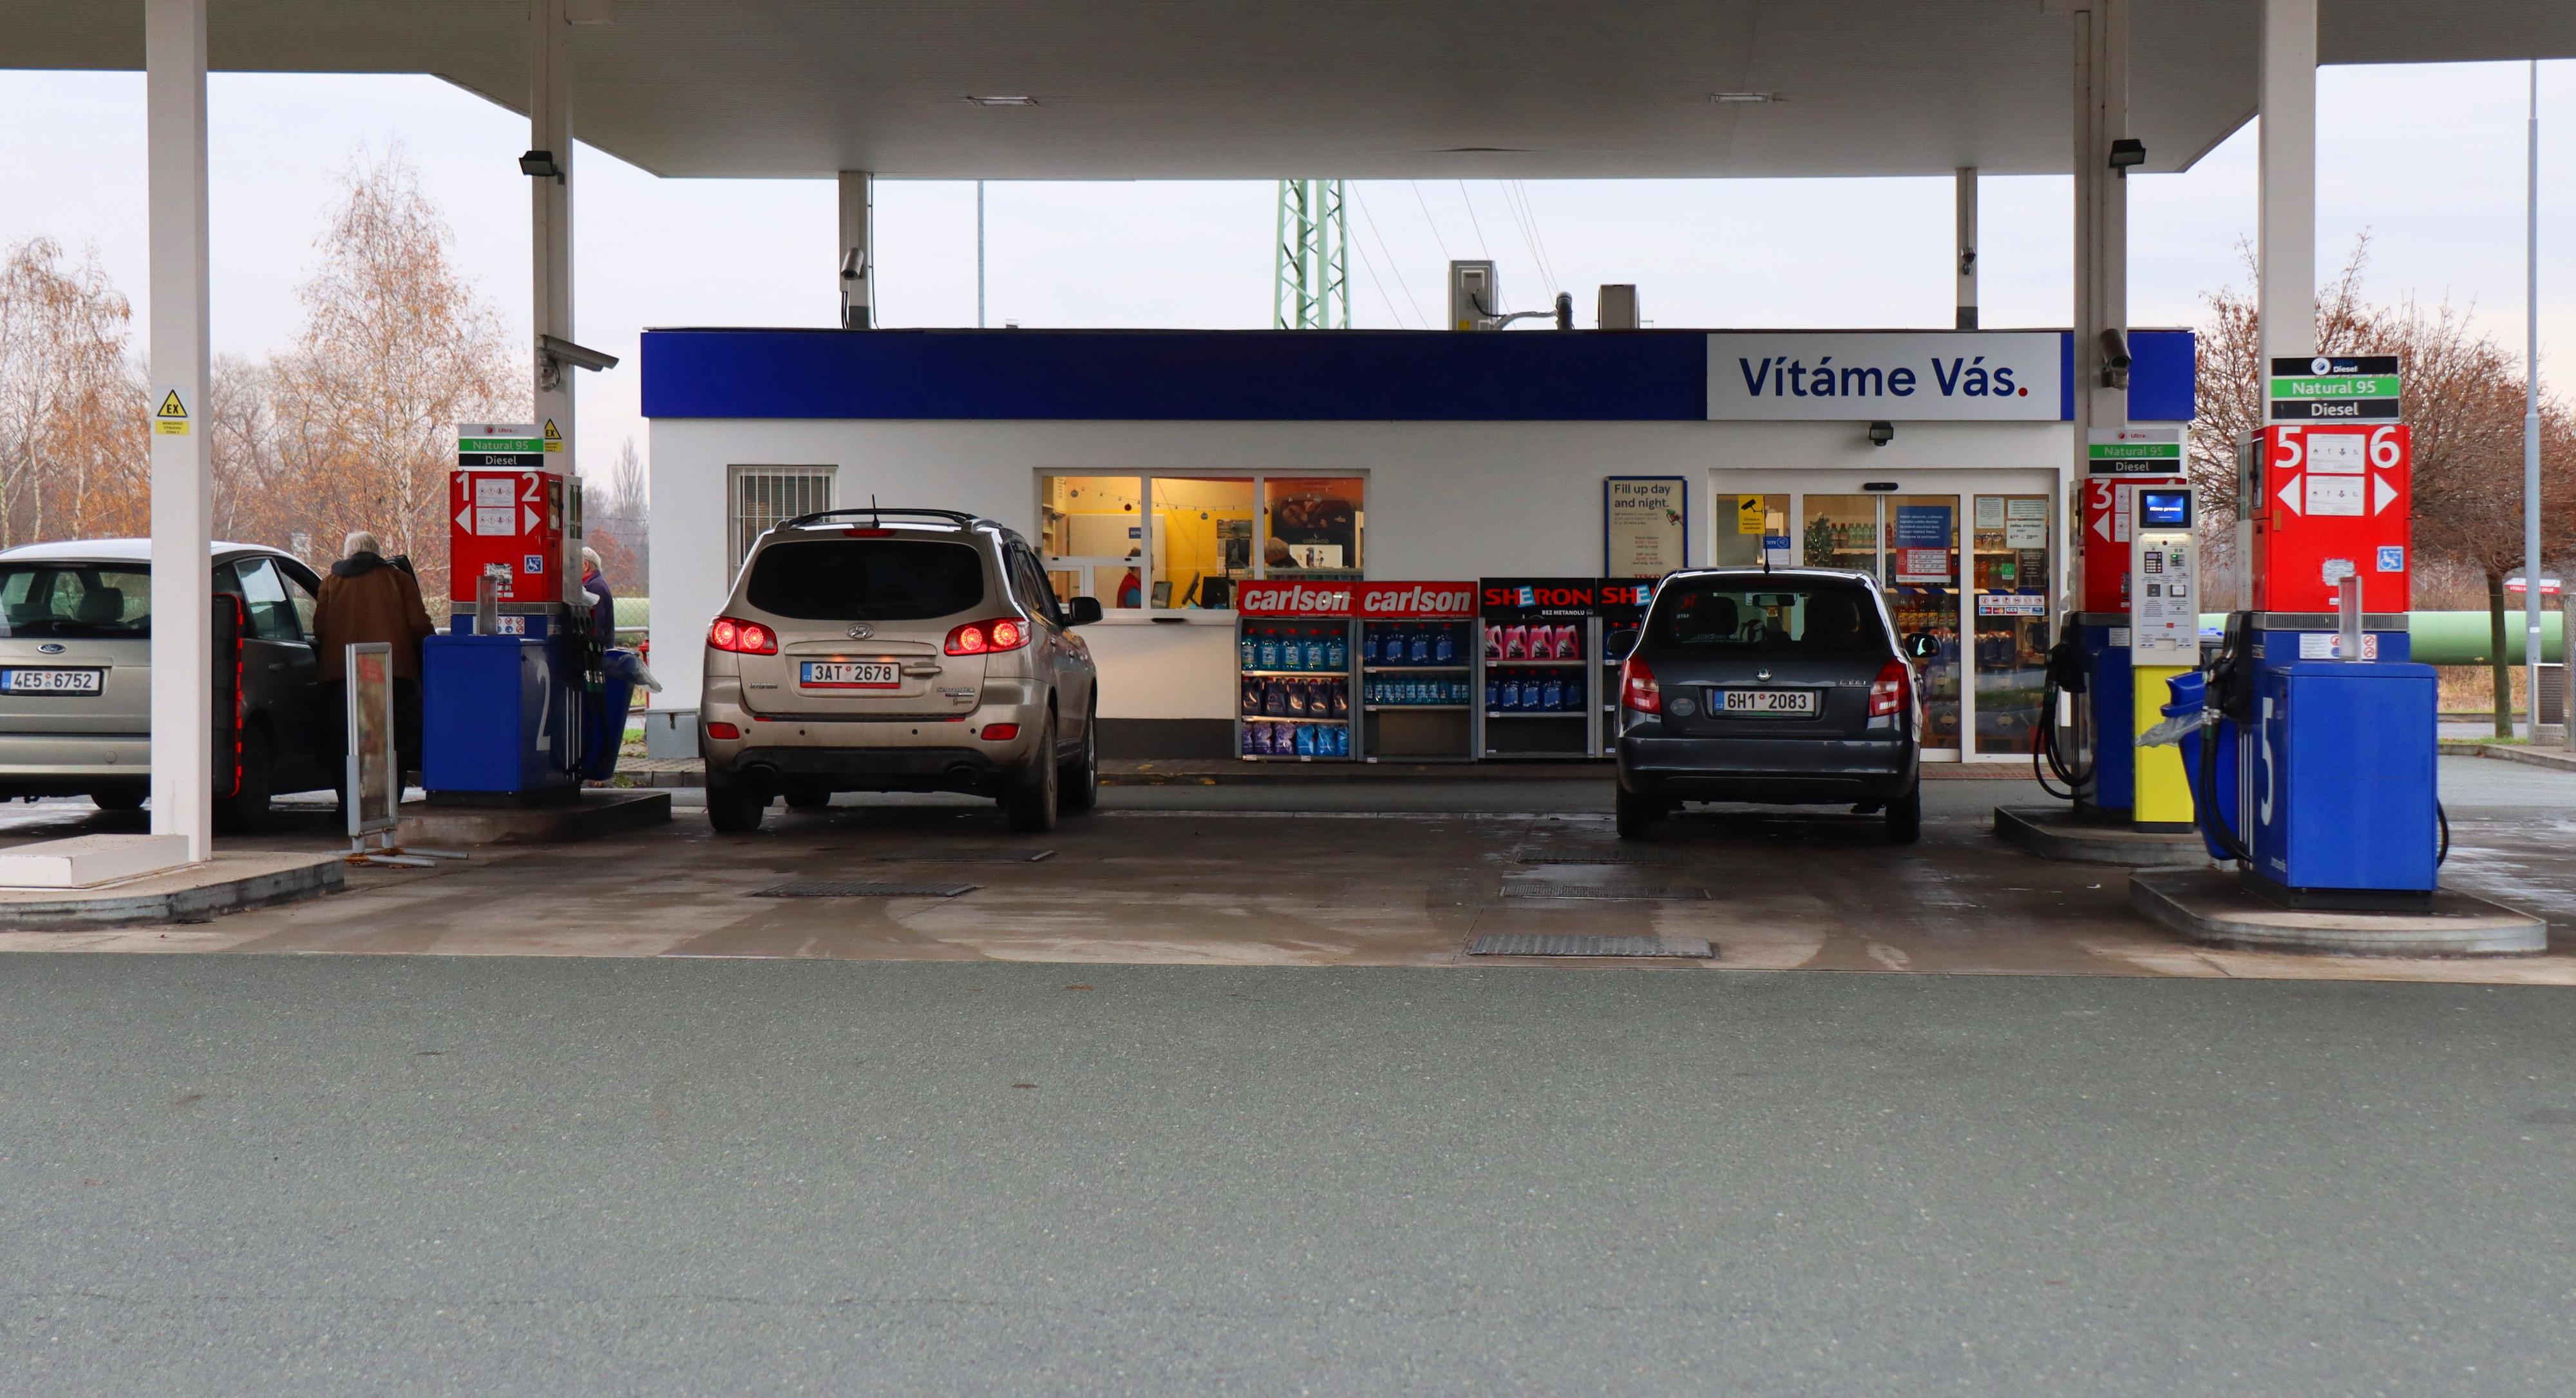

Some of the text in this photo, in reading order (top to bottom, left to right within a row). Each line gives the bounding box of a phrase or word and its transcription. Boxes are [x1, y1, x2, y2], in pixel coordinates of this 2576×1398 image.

[1739, 356, 2028, 397] Vítáme Vás.
[2292, 381, 2376, 395] Natural 95
[167, 404, 179, 414] EX
[2311, 402, 2359, 417] Diesel
[473, 440, 529, 449] Natural 95
[2105, 446, 2164, 456] Natural 95
[2274, 426, 2302, 468] 5
[2369, 426, 2400, 469] 6
[486, 455, 517, 465] Diesel
[2116, 462, 2149, 471] Diesel
[456, 472, 469, 501] 1
[522, 472, 540, 502] 2
[1615, 484, 1671, 496] Fill up day
[2092, 479, 2112, 509] 3
[1615, 498, 1669, 510] and night.
[1244, 585, 1351, 611] carlson
[1364, 586, 1471, 612] carlson
[1484, 587, 1592, 606] SHERON
[1602, 585, 1656, 605] SHE
[14, 673, 92, 688] 4E5 6752
[815, 665, 891, 681] 3AT 2678
[536, 659, 551, 751] 2
[1727, 694, 1807, 709] 6H1 2083
[2260, 697, 2274, 826] 5
